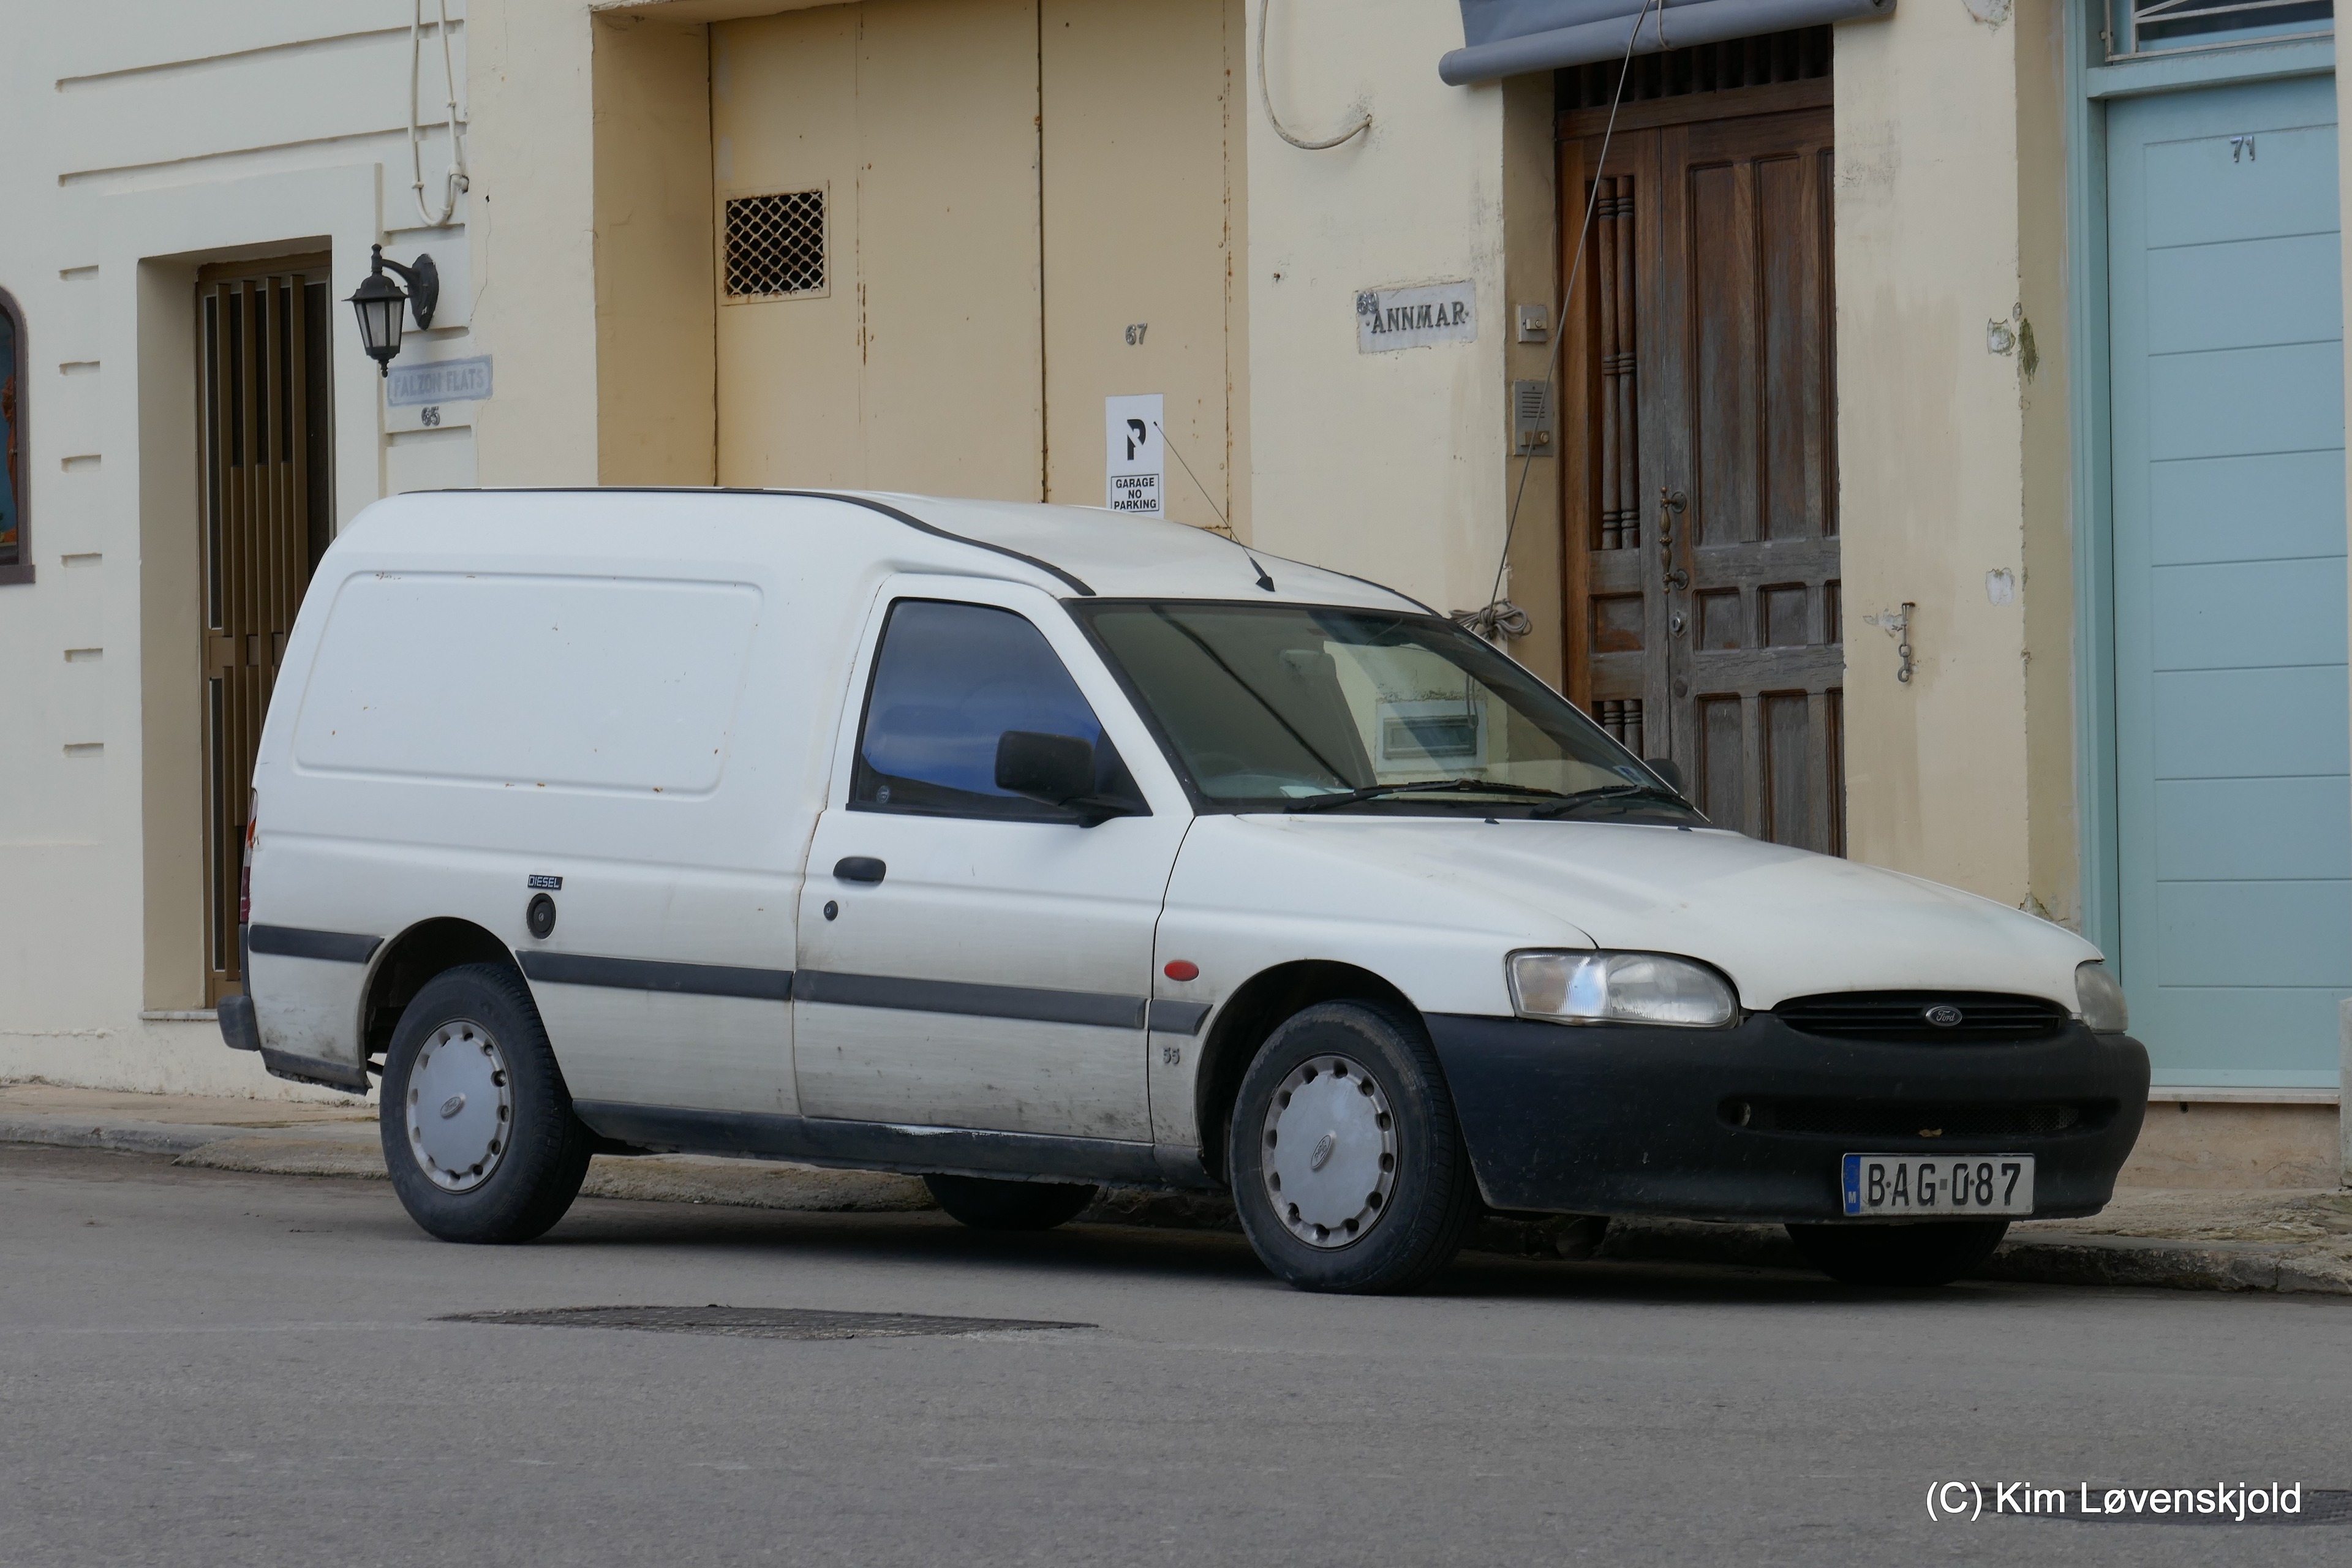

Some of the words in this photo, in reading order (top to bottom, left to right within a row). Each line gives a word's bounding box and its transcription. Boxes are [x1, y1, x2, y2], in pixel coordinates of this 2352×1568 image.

[2230, 136, 2255, 162] 71
[1371, 301, 1466, 334] ANNMAR
[1125, 323, 1147, 345] 67
[393, 372, 442, 398] FALZON
[446, 369, 484, 392] FLATS
[421, 406, 440, 426] 65
[1116, 478, 1155, 488] GARAGE
[1128, 489, 1142, 499] NO
[1114, 499, 1156, 510] PARKING
[528, 876, 560, 888] DIESEL
[1936, 1009, 1955, 1022] Ford
[1163, 1047, 1180, 1065] 55
[1868, 1163, 1936, 1207] BAG
[1951, 1163, 2021, 1207] 087
[1848, 1191, 1856, 1204] M
